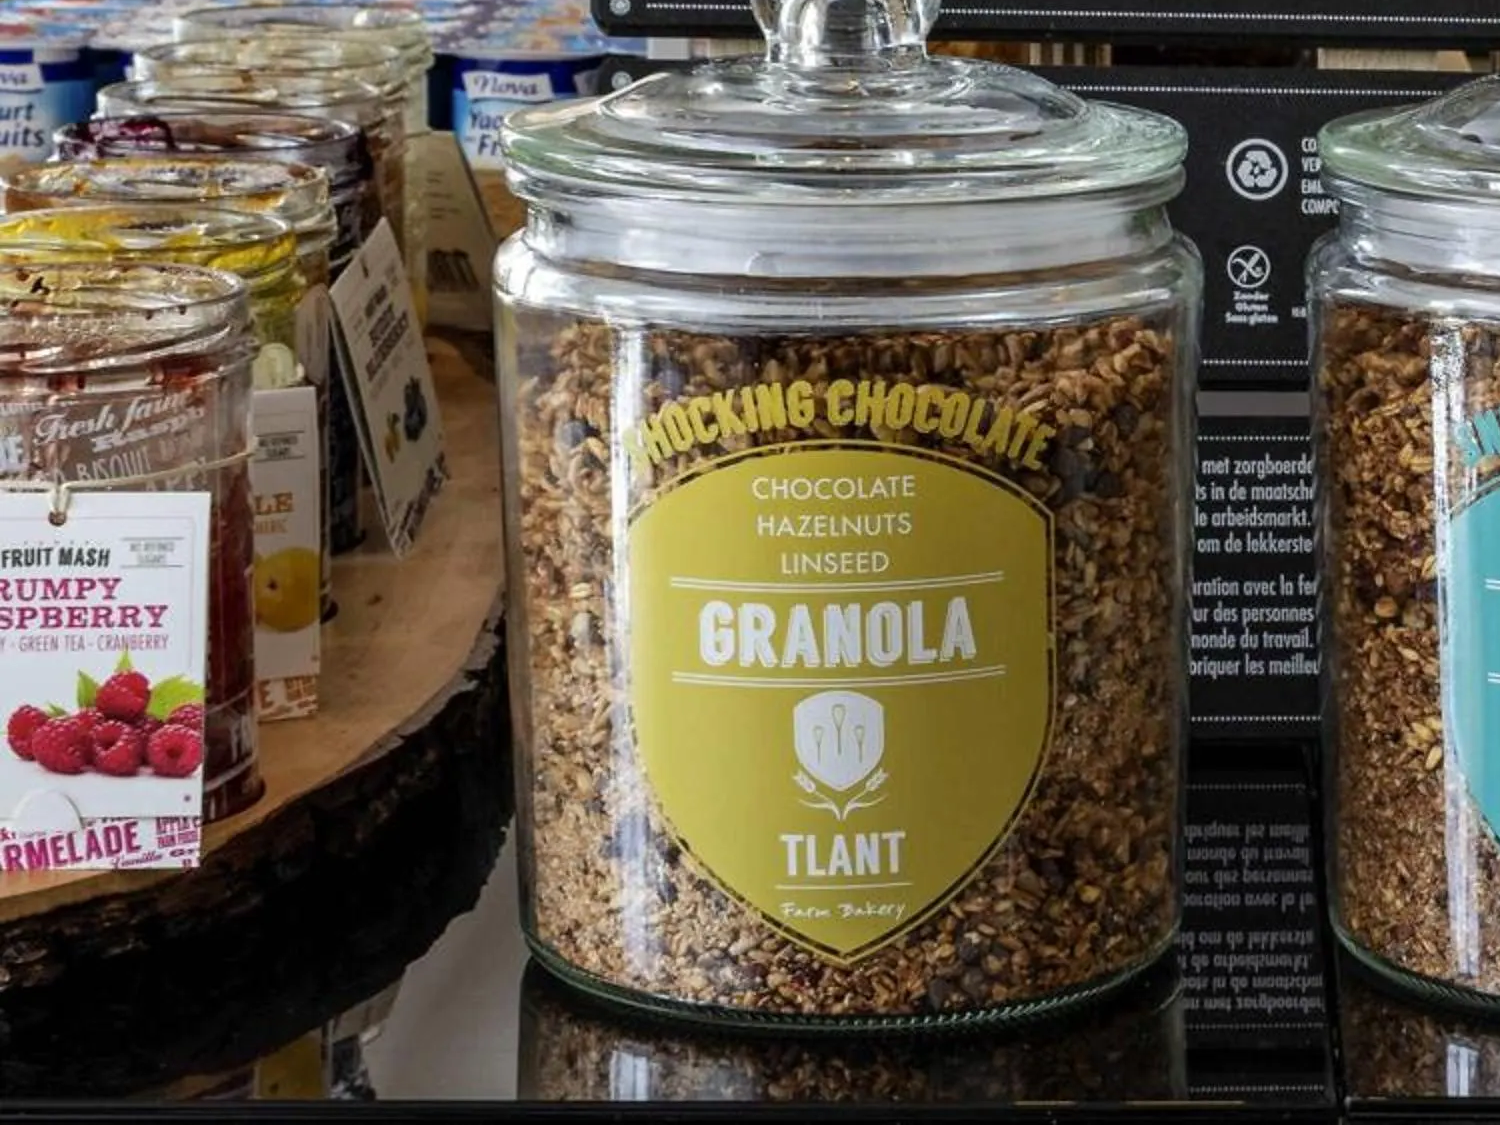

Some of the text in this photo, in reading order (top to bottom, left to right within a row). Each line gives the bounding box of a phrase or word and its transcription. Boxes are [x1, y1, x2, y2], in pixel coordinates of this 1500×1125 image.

[473, 75, 539, 96] Nova
[827, 378, 1057, 472] CHOCOLATE
[1201, 456, 1230, 475] met
[751, 475, 916, 501] CHOCOLATE
[1210, 481, 1225, 500] in
[1228, 479, 1247, 501] de
[756, 512, 912, 538] HAZELNUTS
[1211, 505, 1312, 528] arbeidsmarkt.
[1197, 531, 1313, 554] om de lekkerste
[1, 548, 52, 568] FRUIT
[57, 547, 111, 568] MASH
[781, 551, 890, 575] LINSEED
[1243, 581, 1277, 596] avec
[1280, 574, 1294, 596] la
[1213, 601, 1239, 623] des
[1242, 607, 1315, 628] personnes
[19, 636, 59, 652] GREEN
[63, 635, 86, 651] TEA
[97, 634, 169, 652] CRANBERRY
[699, 596, 977, 668] GRANOLA
[1240, 627, 1259, 648] du
[1263, 627, 1314, 648] travail.
[1245, 653, 1265, 675] les
[779, 831, 906, 877] TLANT
[780, 904, 830, 919] Farm
